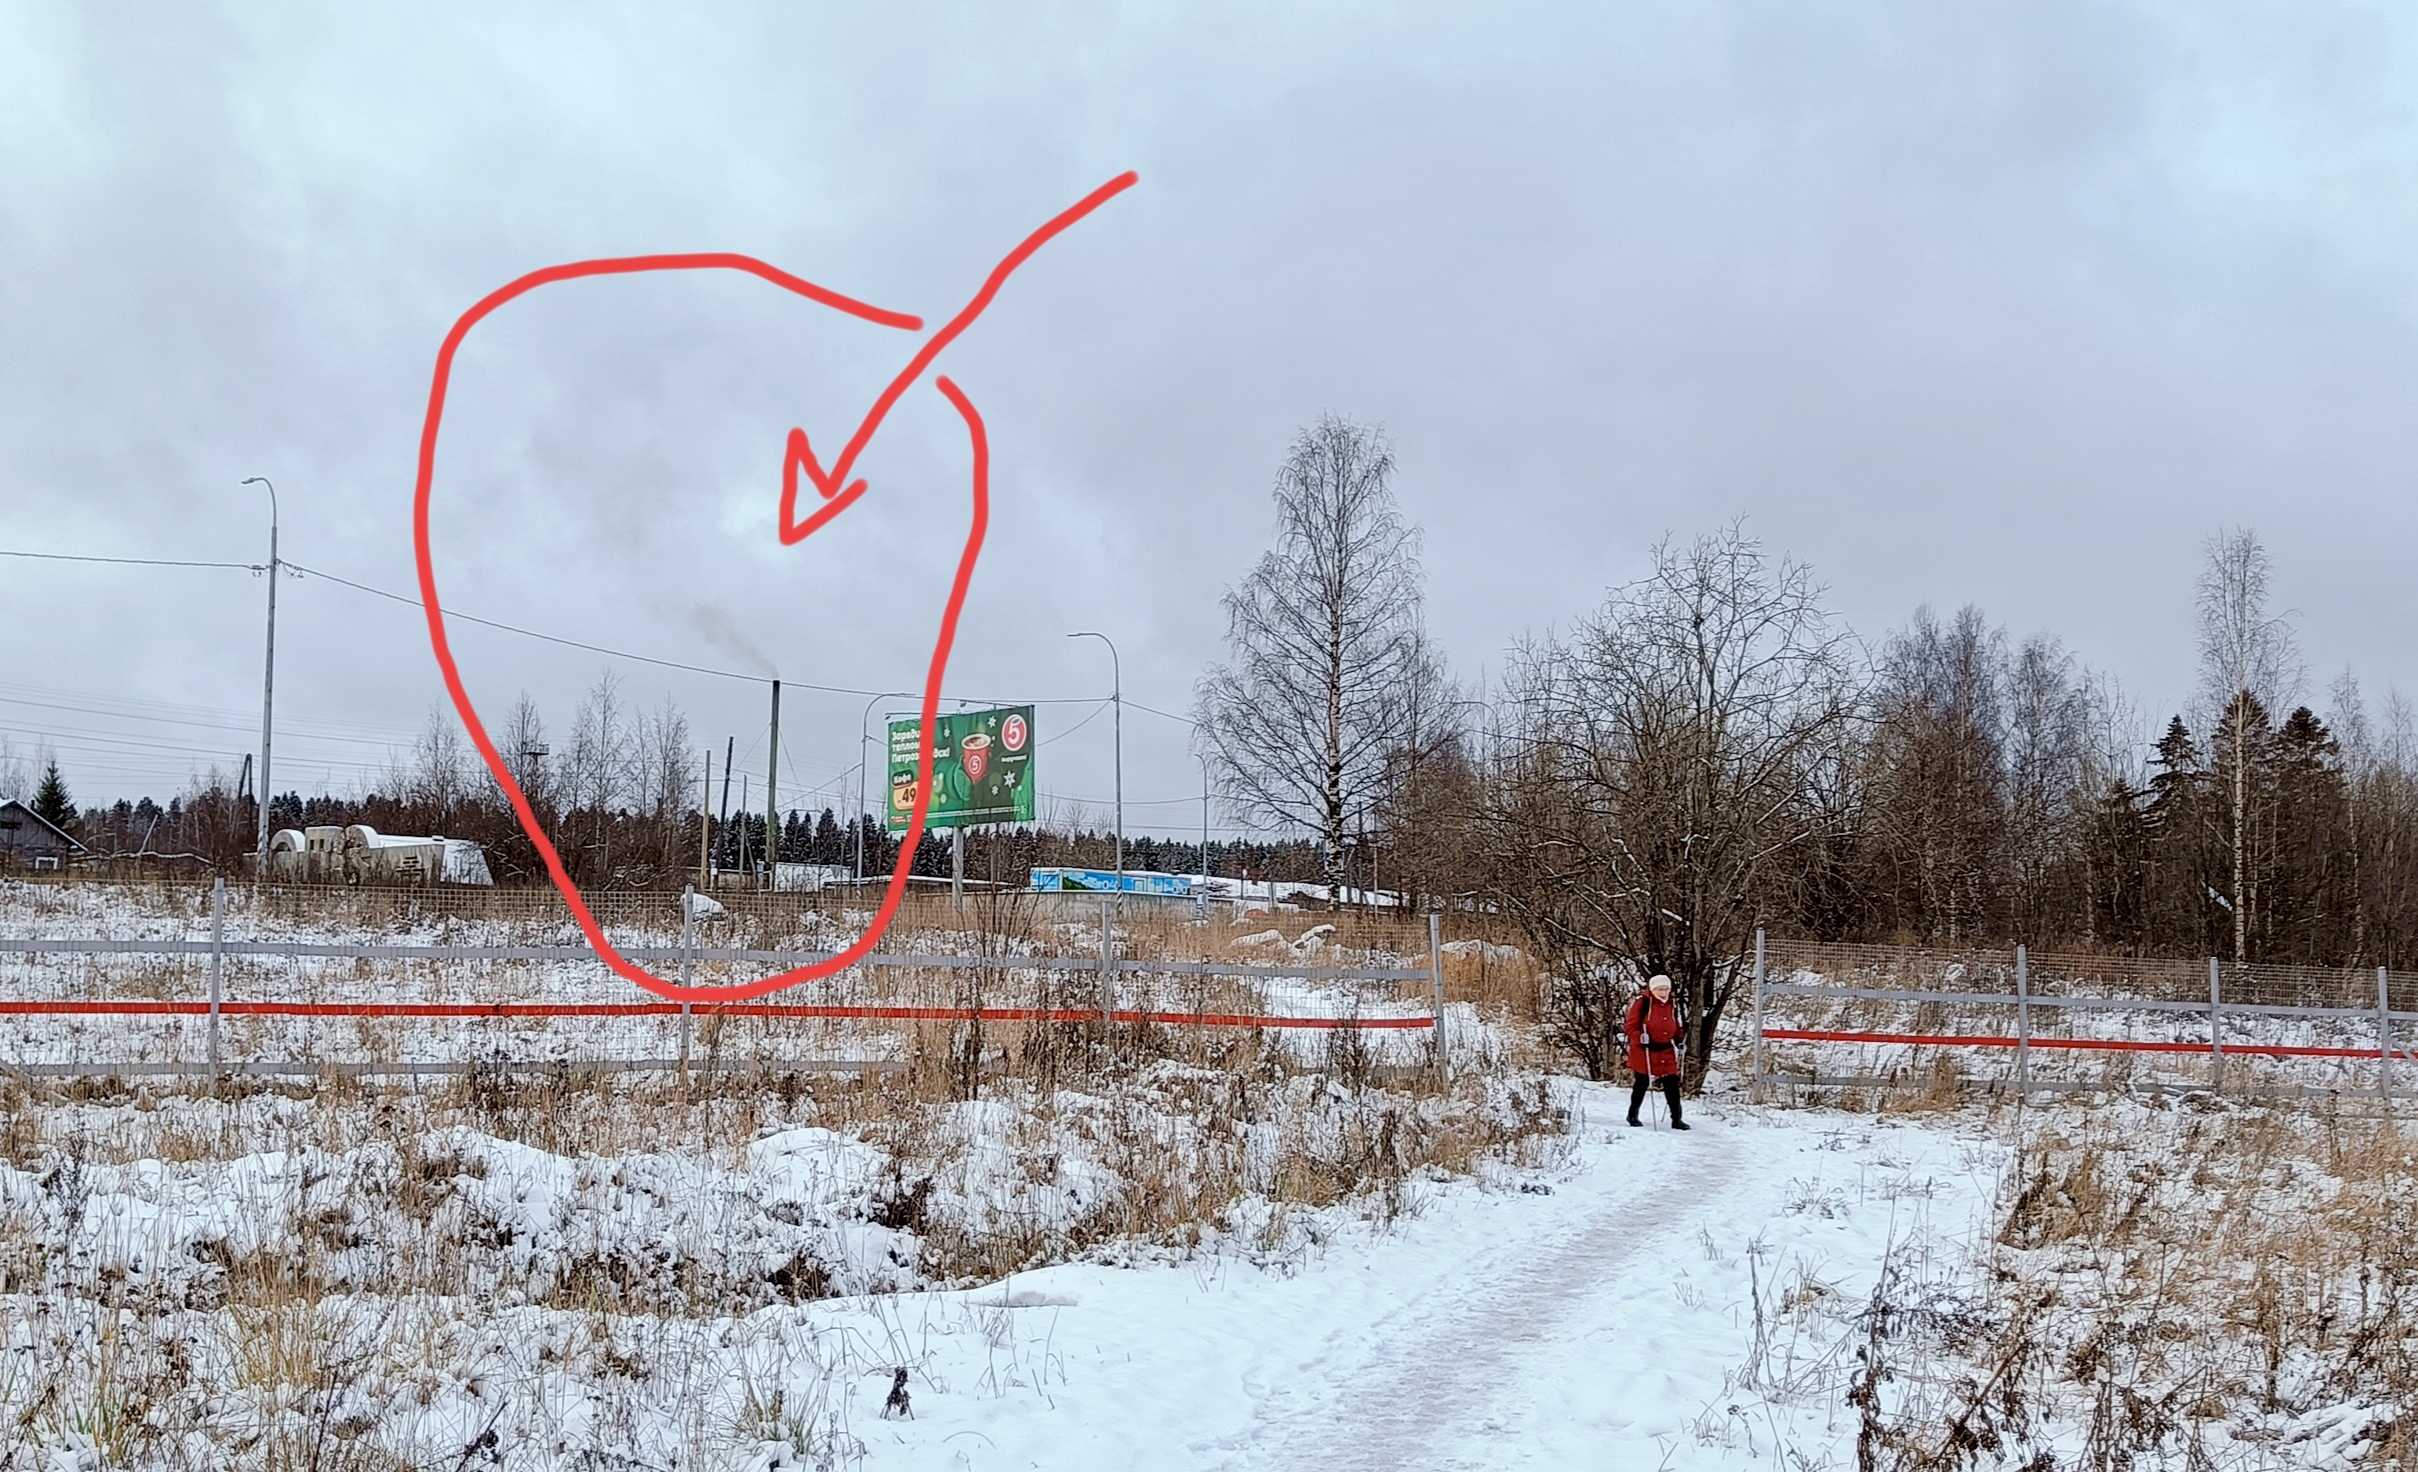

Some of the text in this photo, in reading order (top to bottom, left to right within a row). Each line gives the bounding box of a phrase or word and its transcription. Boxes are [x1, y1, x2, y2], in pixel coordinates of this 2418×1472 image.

[892, 729, 921, 742] Заряди
[892, 746, 950, 764] Петроздск!
[893, 773, 911, 784] Кофе
[902, 787, 917, 803] 49
